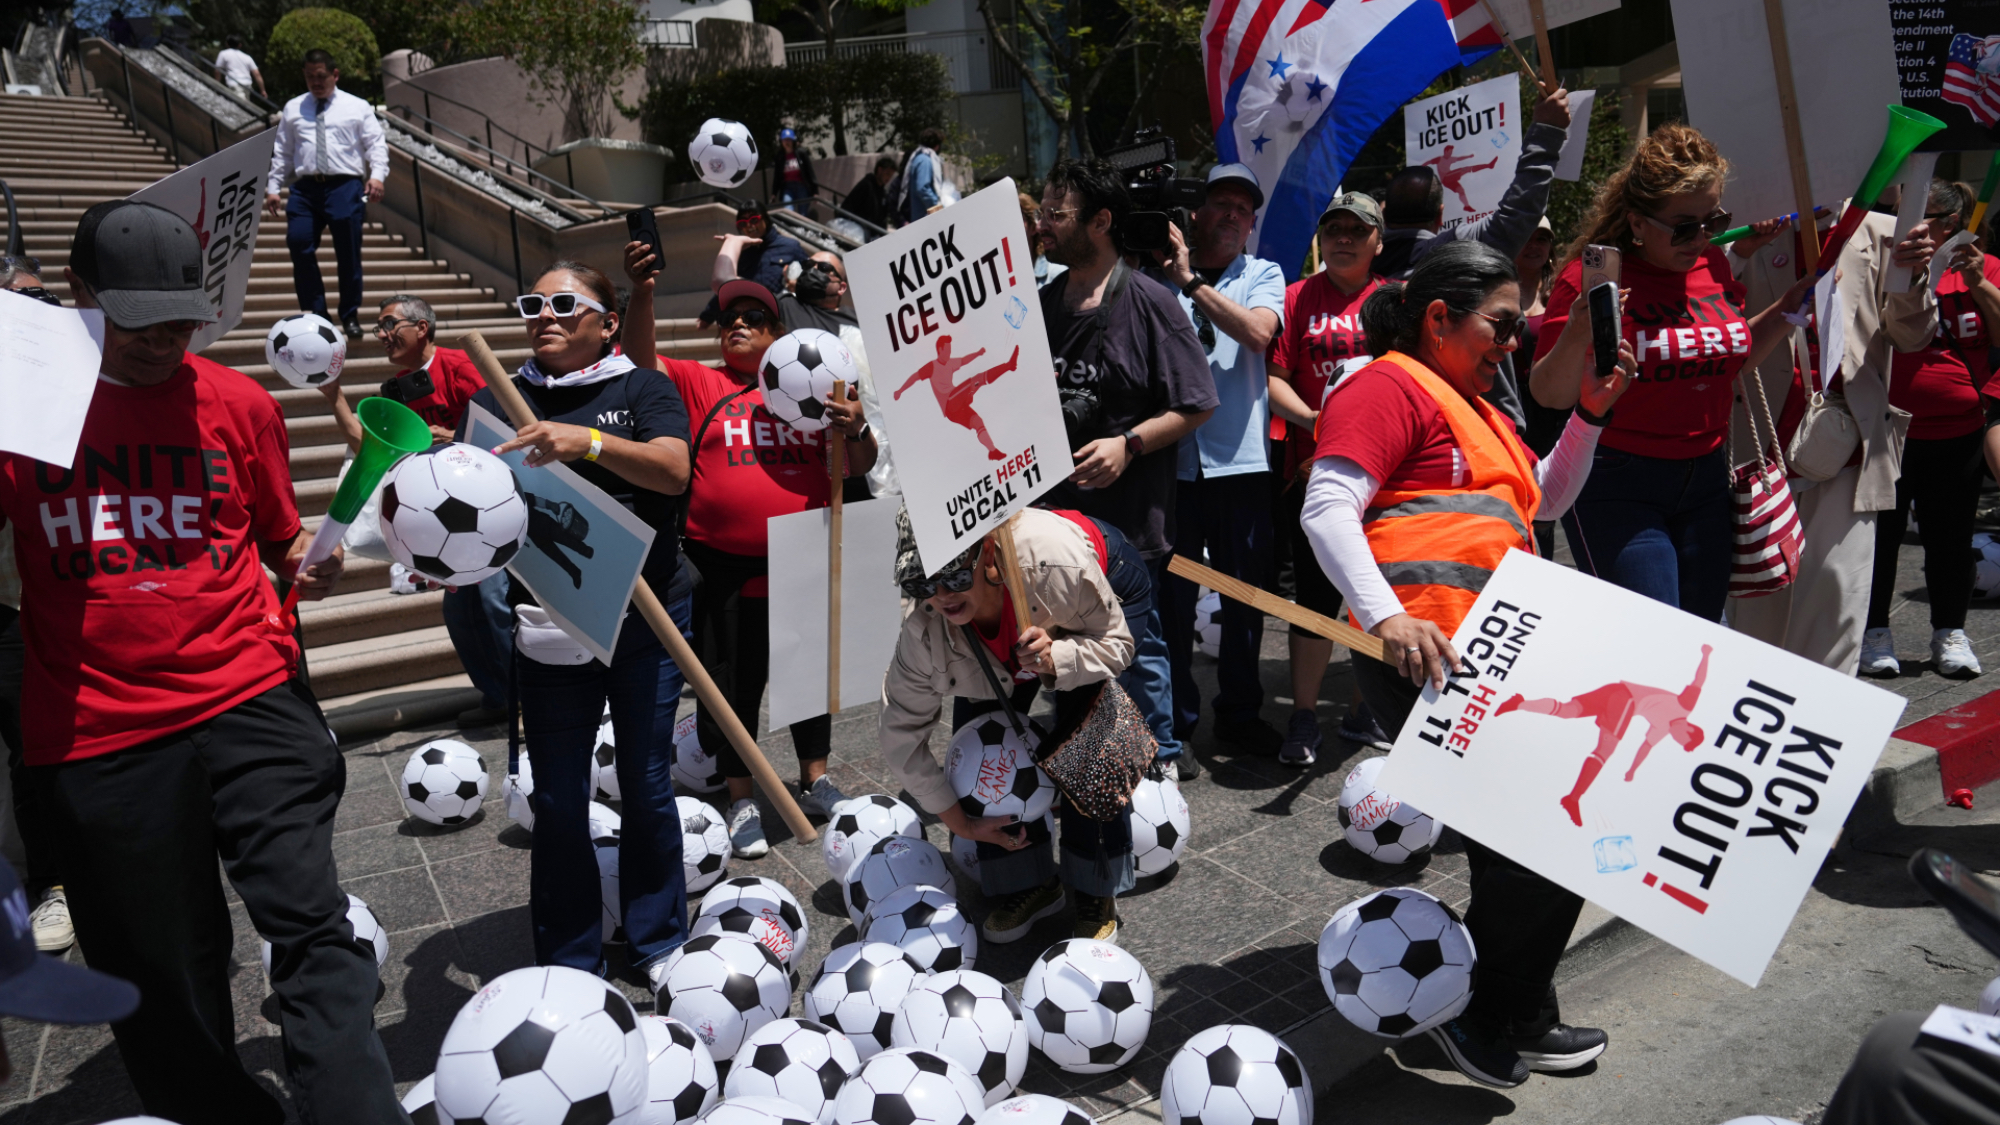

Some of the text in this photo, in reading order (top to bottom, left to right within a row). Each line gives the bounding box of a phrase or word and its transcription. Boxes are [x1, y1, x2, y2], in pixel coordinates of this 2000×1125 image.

[1892, 24, 1954, 36] endment
[1893, 8, 1945, 20] the 14th
[1896, 56, 1936, 67] tion 4
[1906, 72, 1930, 83] U.S.
[1426, 94, 1471, 127] KICK
[1900, 87, 1941, 98] itution
[1419, 102, 1505, 150] ICE OUT!
[213, 170, 241, 234] ICE
[230, 175, 258, 264] KICK
[1440, 217, 1463, 231] NITE
[888, 223, 965, 301] KICK
[885, 236, 1017, 353] ICE OUT!
[1309, 312, 1364, 335] UNI
[1636, 321, 1748, 362] HERE
[1309, 332, 1367, 361] HER
[1637, 357, 1728, 383] LOCAL
[35, 443, 230, 494] UNITE
[727, 447, 809, 468] LOCAL
[946, 444, 1037, 517] UNITE HERE!
[951, 462, 1042, 540] LOCAL 11
[51, 544, 187, 581] LOCAL
[1418, 599, 1520, 747] LOCAL 11
[1445, 611, 1542, 759] UNITE HERE!
[977, 758, 996, 799] FAIR
[990, 749, 1016, 805] GAMES
[1746, 725, 1843, 855] KICK
[1349, 795, 1378, 822] FAIR
[1355, 797, 1400, 832] GAMES
[1642, 679, 1797, 915] ICE OUT!
[760, 930, 787, 962] FAIR
